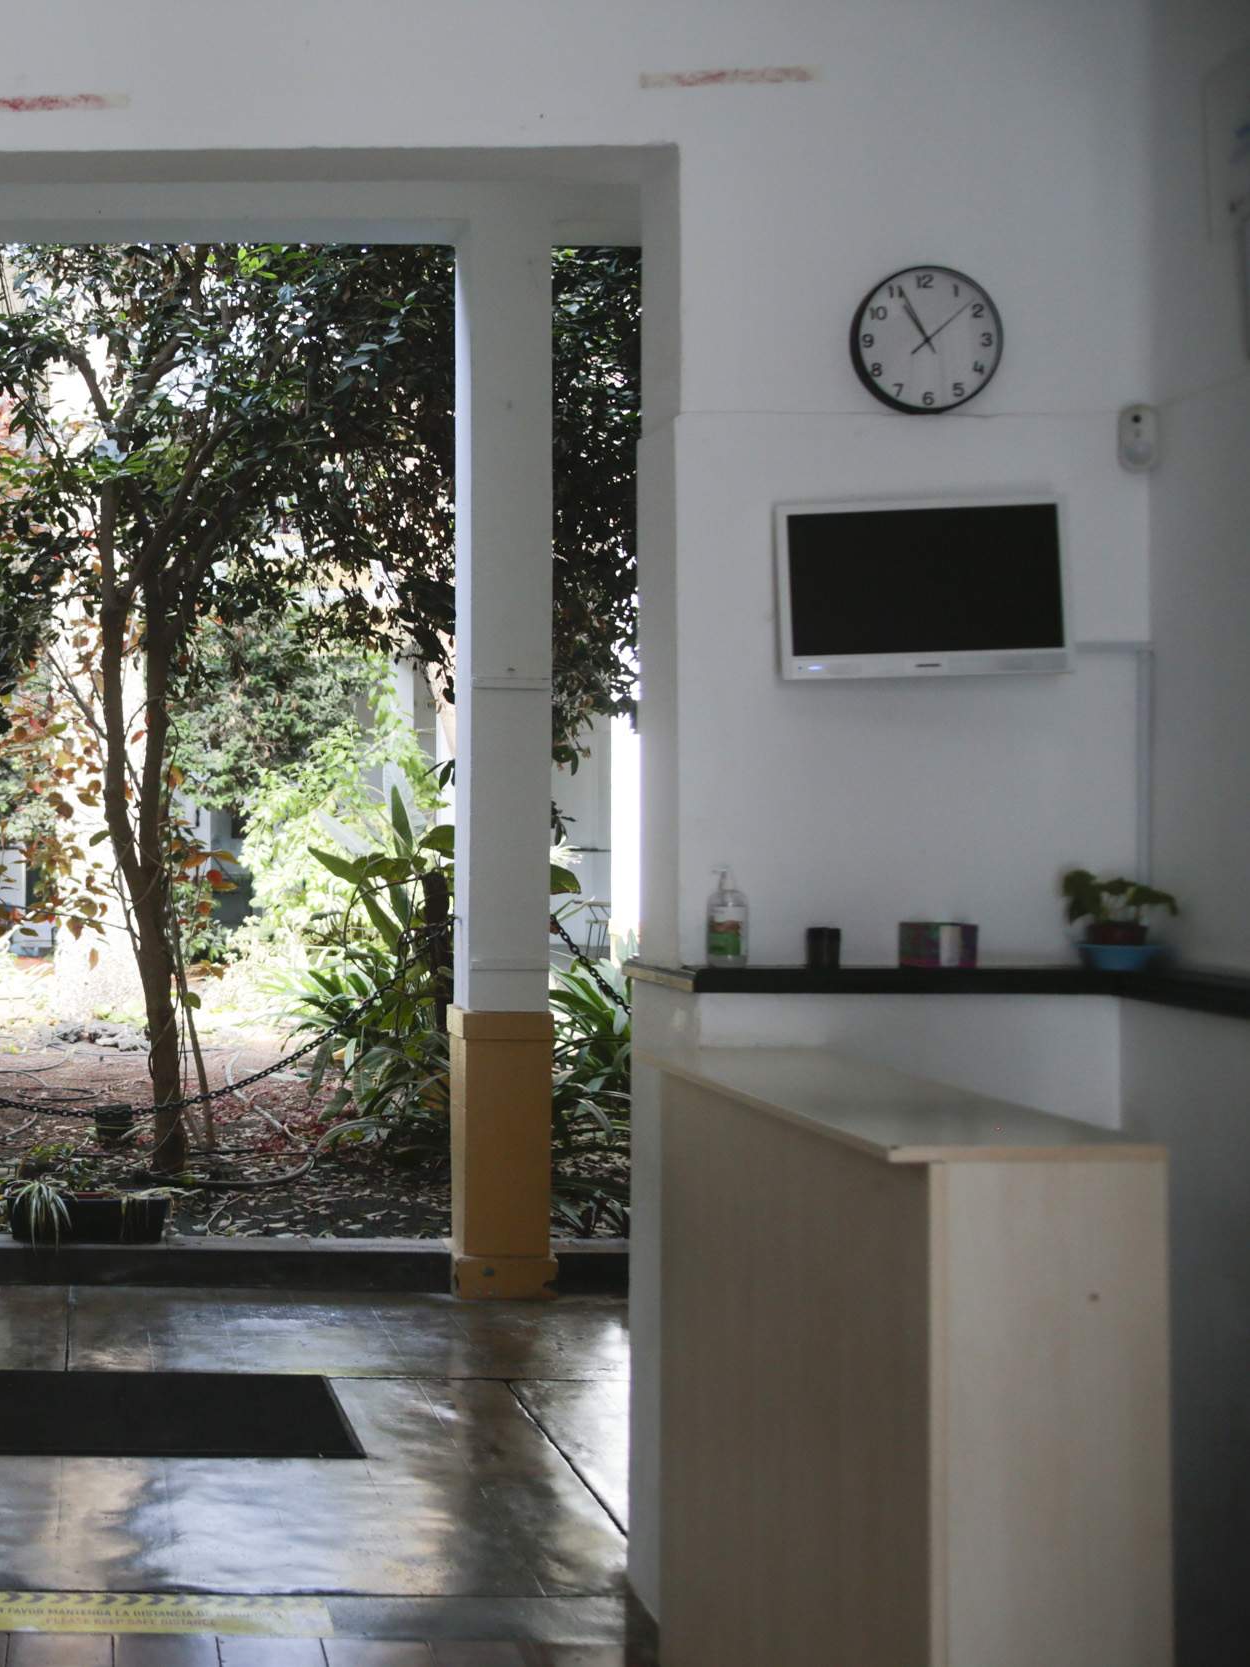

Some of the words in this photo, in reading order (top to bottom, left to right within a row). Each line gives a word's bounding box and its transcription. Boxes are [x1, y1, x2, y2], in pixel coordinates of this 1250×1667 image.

[916, 274, 934, 289] 12
[888, 286, 903, 298] 11
[952, 284, 959, 297] 1
[869, 306, 887, 320] 10
[972, 303, 984, 318] 2
[862, 333, 874, 348] 9
[981, 333, 993, 347] 3
[871, 362, 883, 377] 8
[973, 361, 985, 375] 4
[893, 383, 904, 397] 7
[952, 382, 965, 397] 5
[922, 391, 935, 406] 6
[8, 1607, 44, 1615] FAVOR
[47, 1608, 110, 1616] MANTENGA
